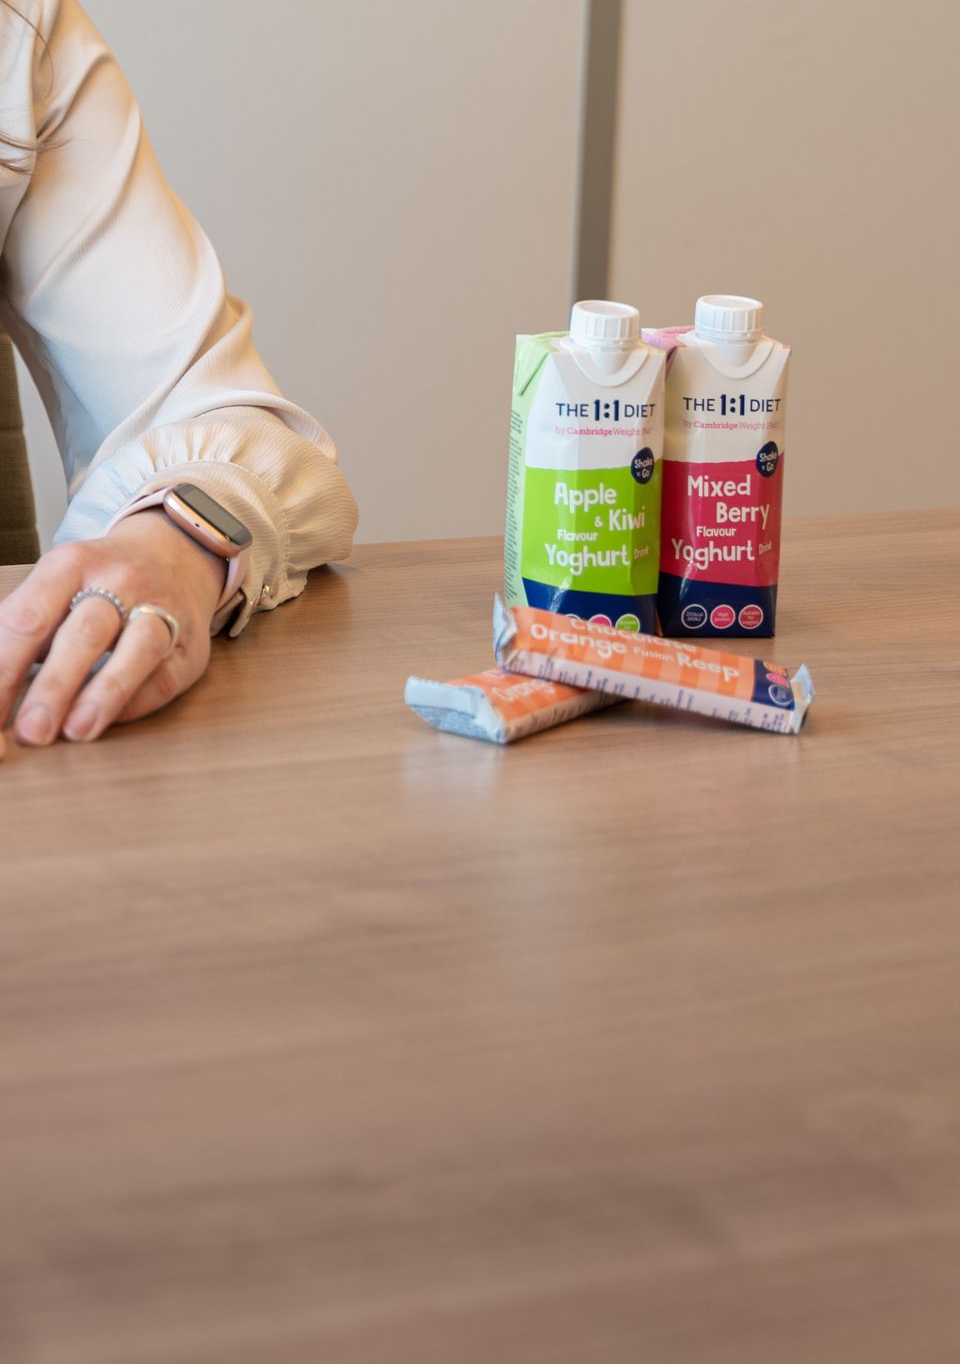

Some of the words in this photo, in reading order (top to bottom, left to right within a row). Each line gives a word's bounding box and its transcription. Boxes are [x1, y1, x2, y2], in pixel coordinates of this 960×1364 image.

[555, 402, 589, 417] THE
[593, 399, 620, 421] 1:1
[624, 403, 656, 418] DIET
[682, 396, 716, 411] THE
[720, 393, 745, 416] 1:1
[750, 398, 781, 412] DIET
[567, 427, 613, 437] Cambridge
[693, 421, 738, 431] Cambridge
[687, 474, 751, 497] Mixed
[554, 481, 617, 514] Apple
[594, 515, 603, 528] &
[608, 505, 645, 531] Kiwi
[716, 502, 770, 530] Berry
[557, 528, 598, 541] Flavour
[696, 525, 736, 537] Flavour
[544, 543, 630, 576] Yoghurt
[671, 538, 755, 570] Yoghurt
[530, 623, 627, 659] Orange
[633, 646, 674, 662] Fusion
[676, 652, 739, 682] Reep
[491, 679, 556, 702] Orang
